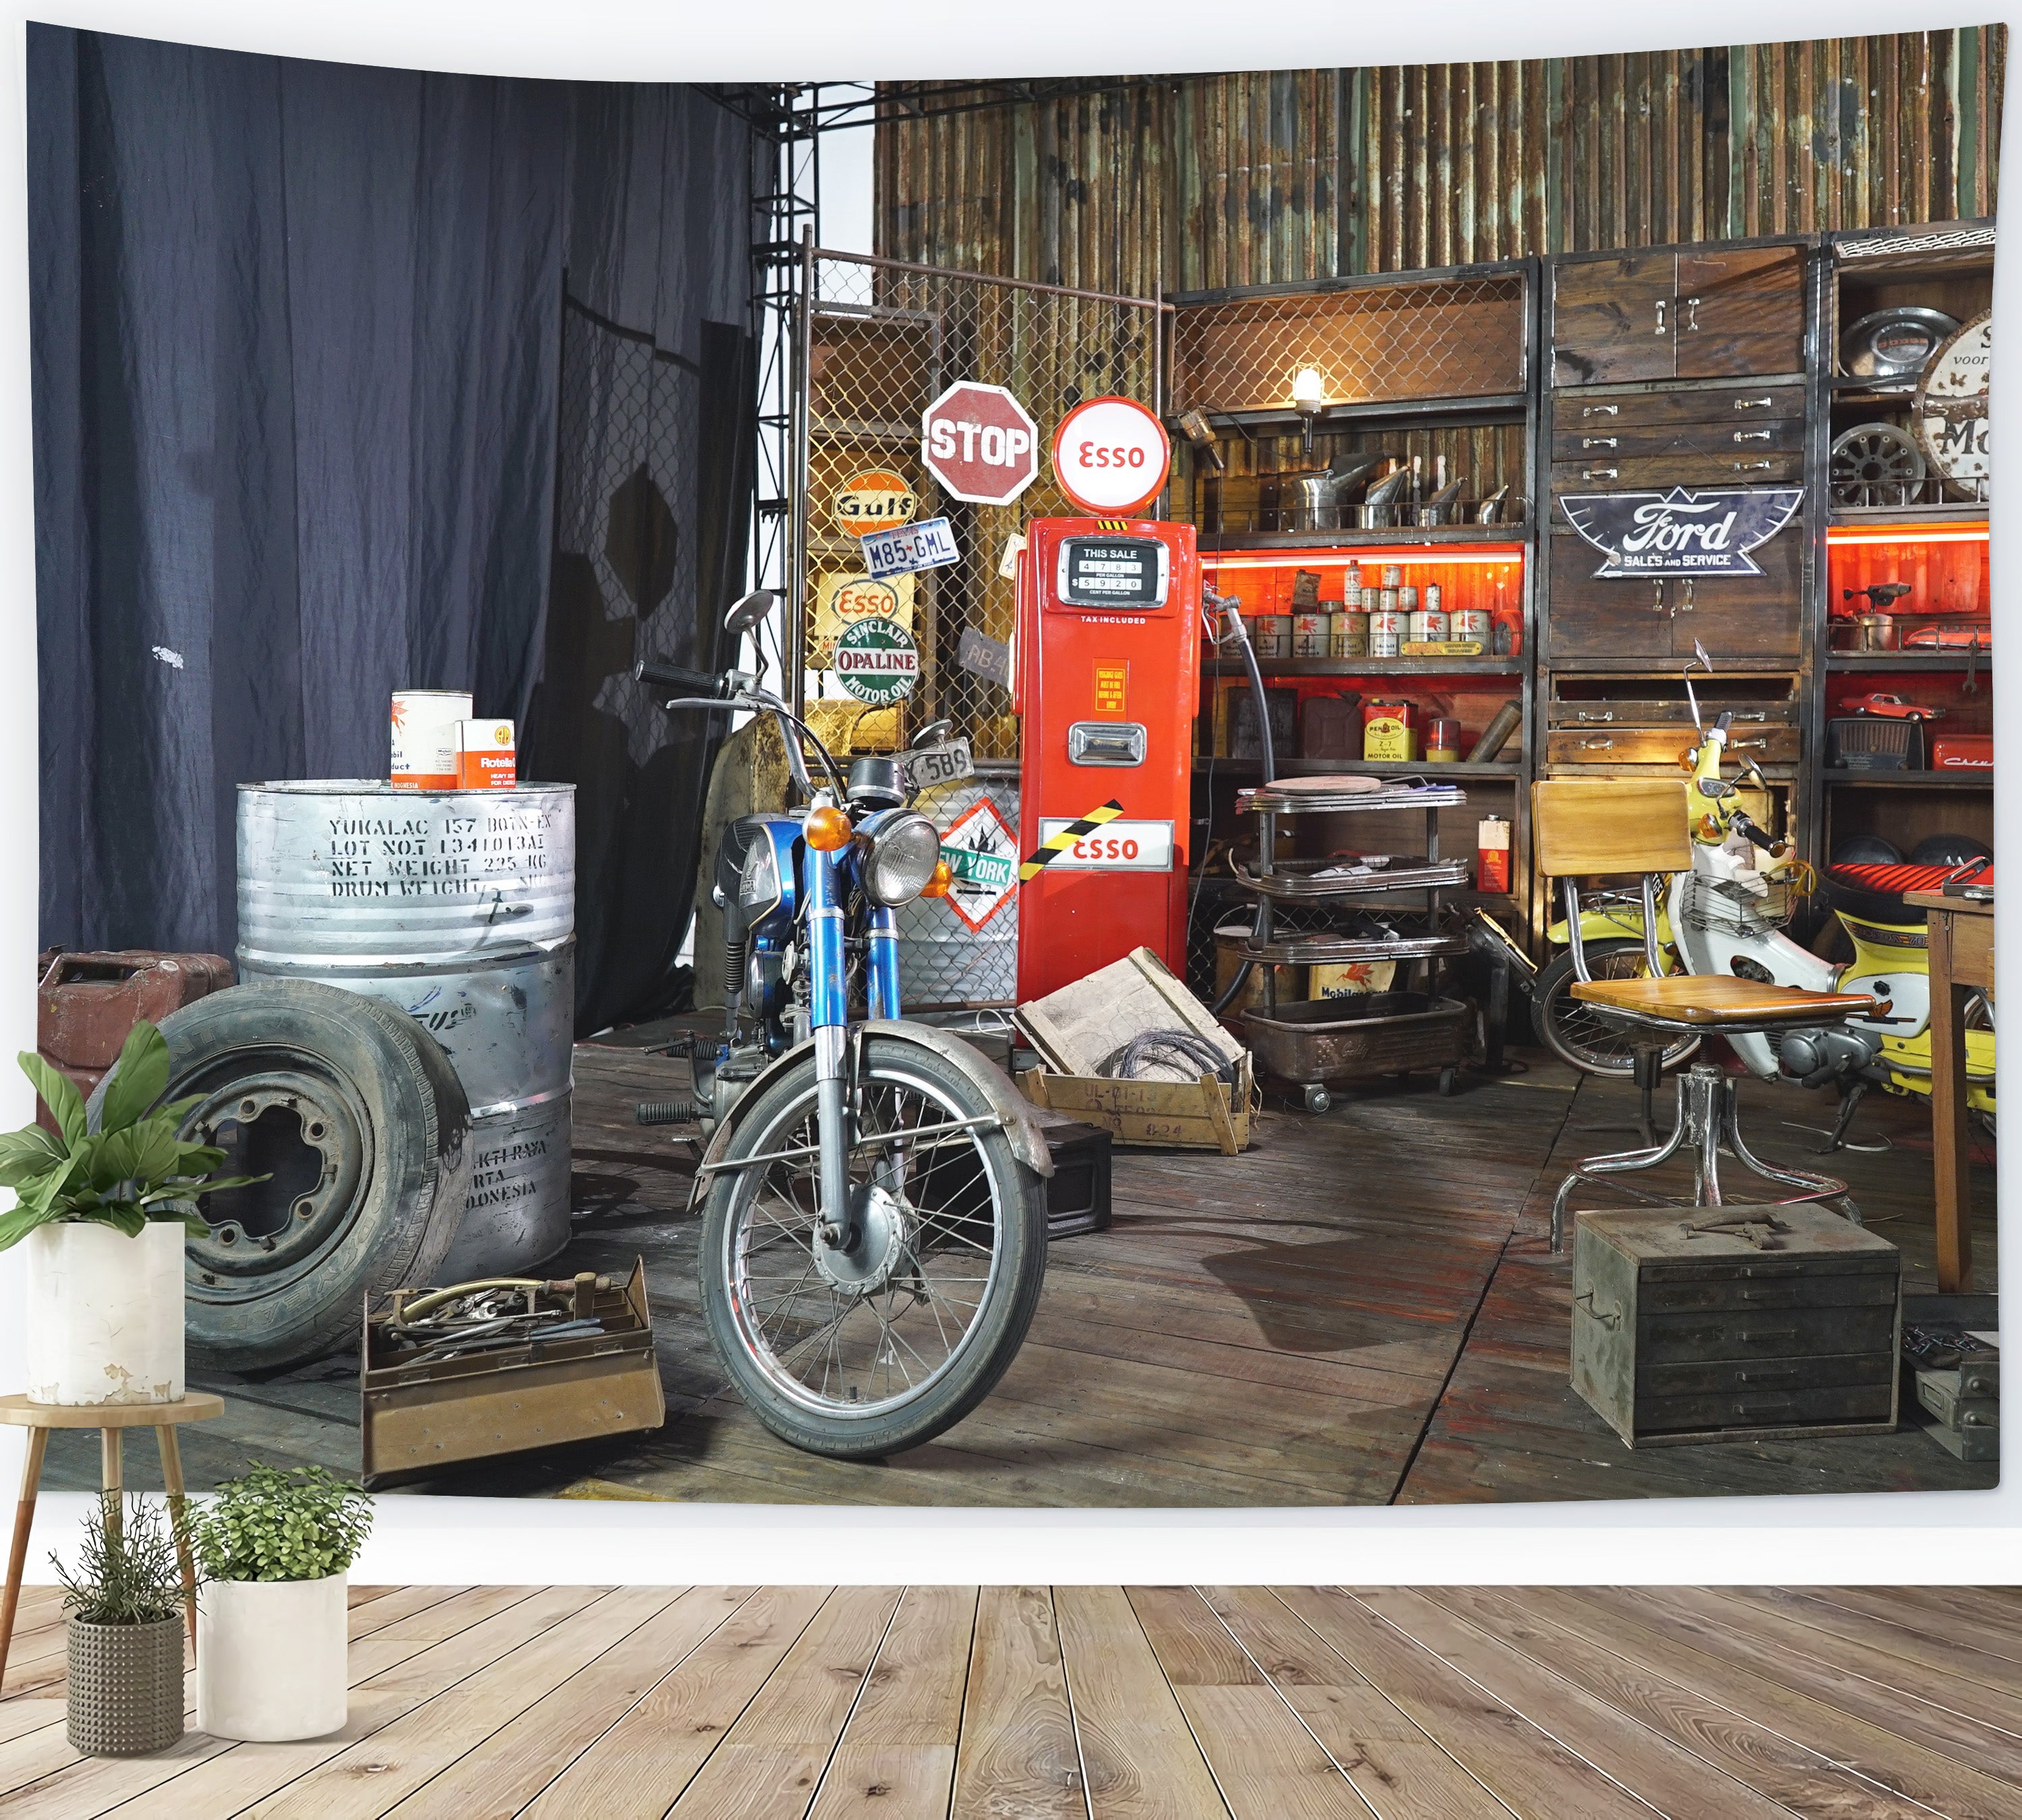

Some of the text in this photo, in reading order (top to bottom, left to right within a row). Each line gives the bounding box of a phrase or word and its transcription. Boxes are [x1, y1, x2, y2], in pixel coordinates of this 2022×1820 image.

[1954, 356, 1988, 365] voor
[931, 418, 1030, 468] STOP
[837, 495, 912, 516] Gulf
[890, 526, 919, 539] TEXAS
[1622, 502, 1737, 551] Ford
[1084, 549, 1137, 559] THIS SALE
[1624, 555, 1663, 567] SALES
[1682, 554, 1731, 566] SERVICE
[847, 621, 909, 648] SINCLAIR
[838, 650, 916, 671] OPALINE
[845, 675, 912, 702] MOTOR OIL
[330, 820, 428, 835] YUKALAC
[446, 818, 477, 834] 157
[332, 841, 370, 855] LOT
[332, 861, 372, 876] NET
[388, 859, 470, 876] WEIGHT
[967, 854, 1010, 884] YORK
[332, 880, 389, 897] DRUM
[400, 878, 479, 896] WEIGHT
